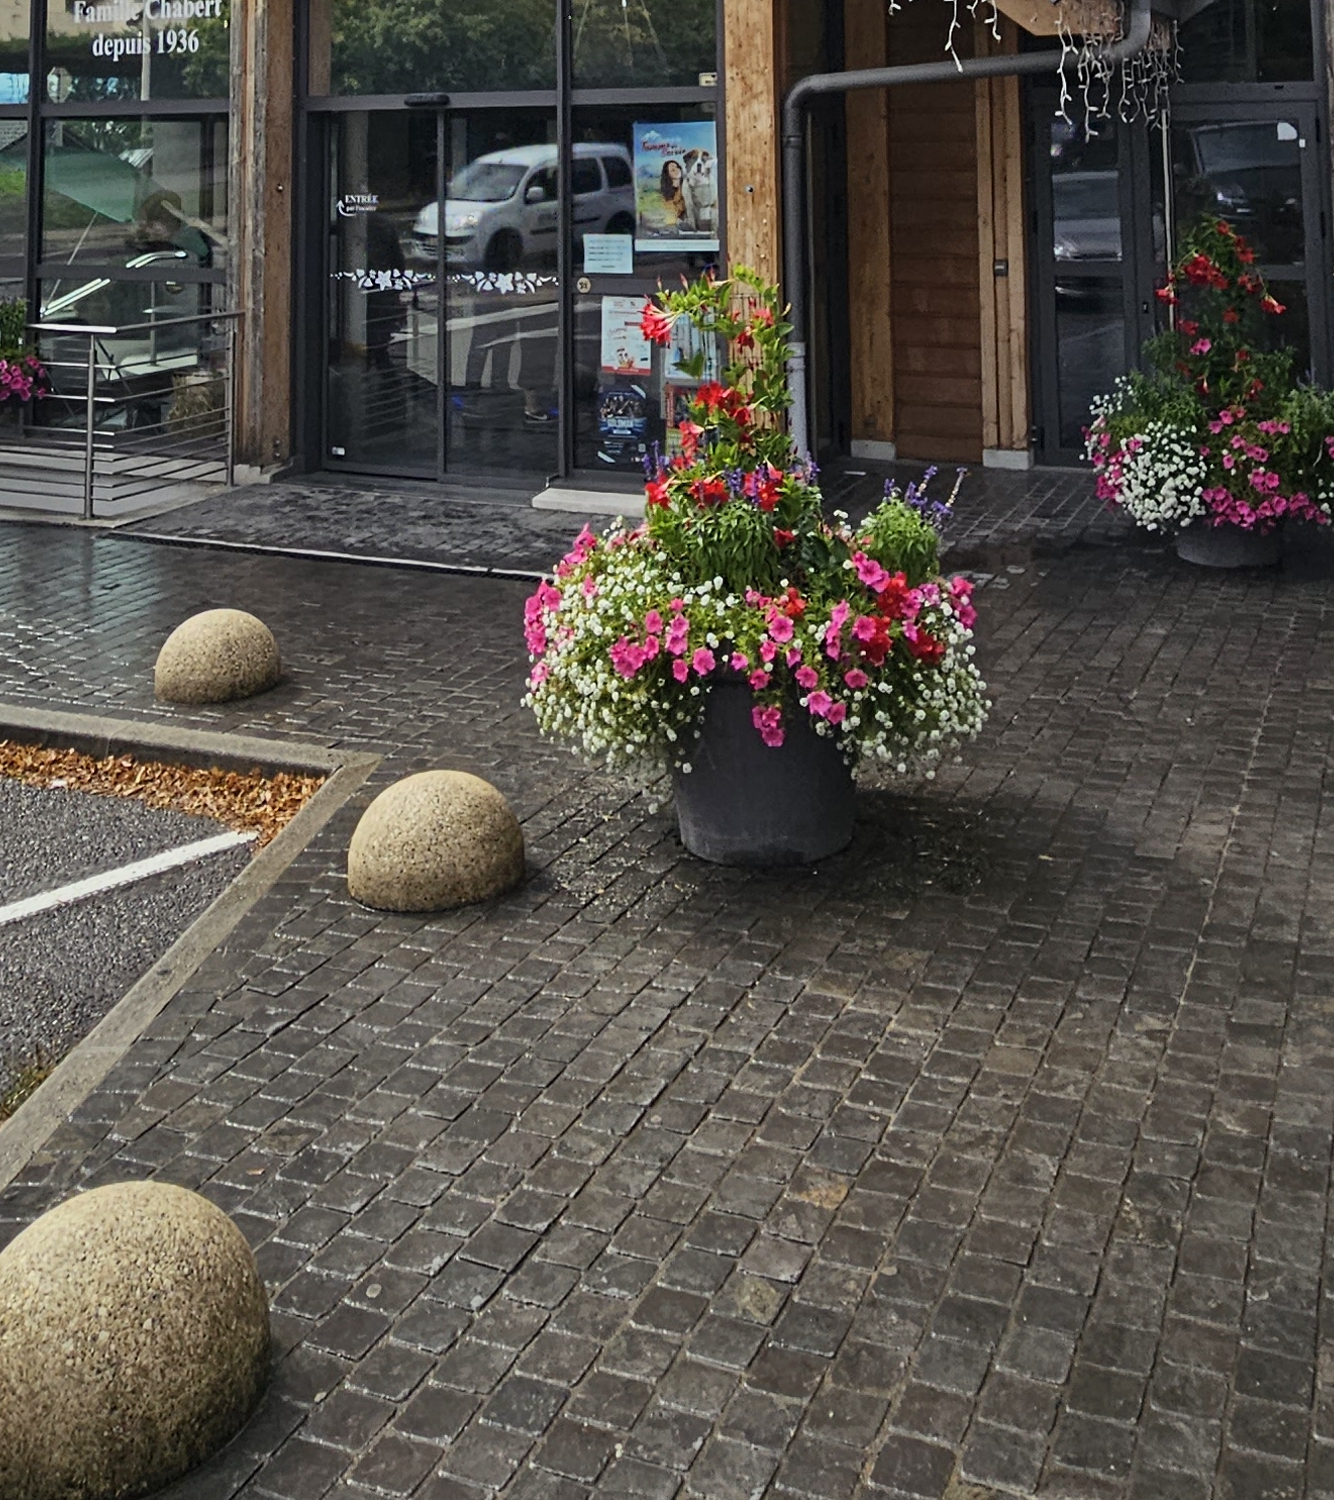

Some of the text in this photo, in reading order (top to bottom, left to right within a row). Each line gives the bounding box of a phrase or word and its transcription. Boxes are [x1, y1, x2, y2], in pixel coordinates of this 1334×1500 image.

[92, 28, 199, 62] depuis 1936
[345, 193, 379, 204] ENTRÉE
